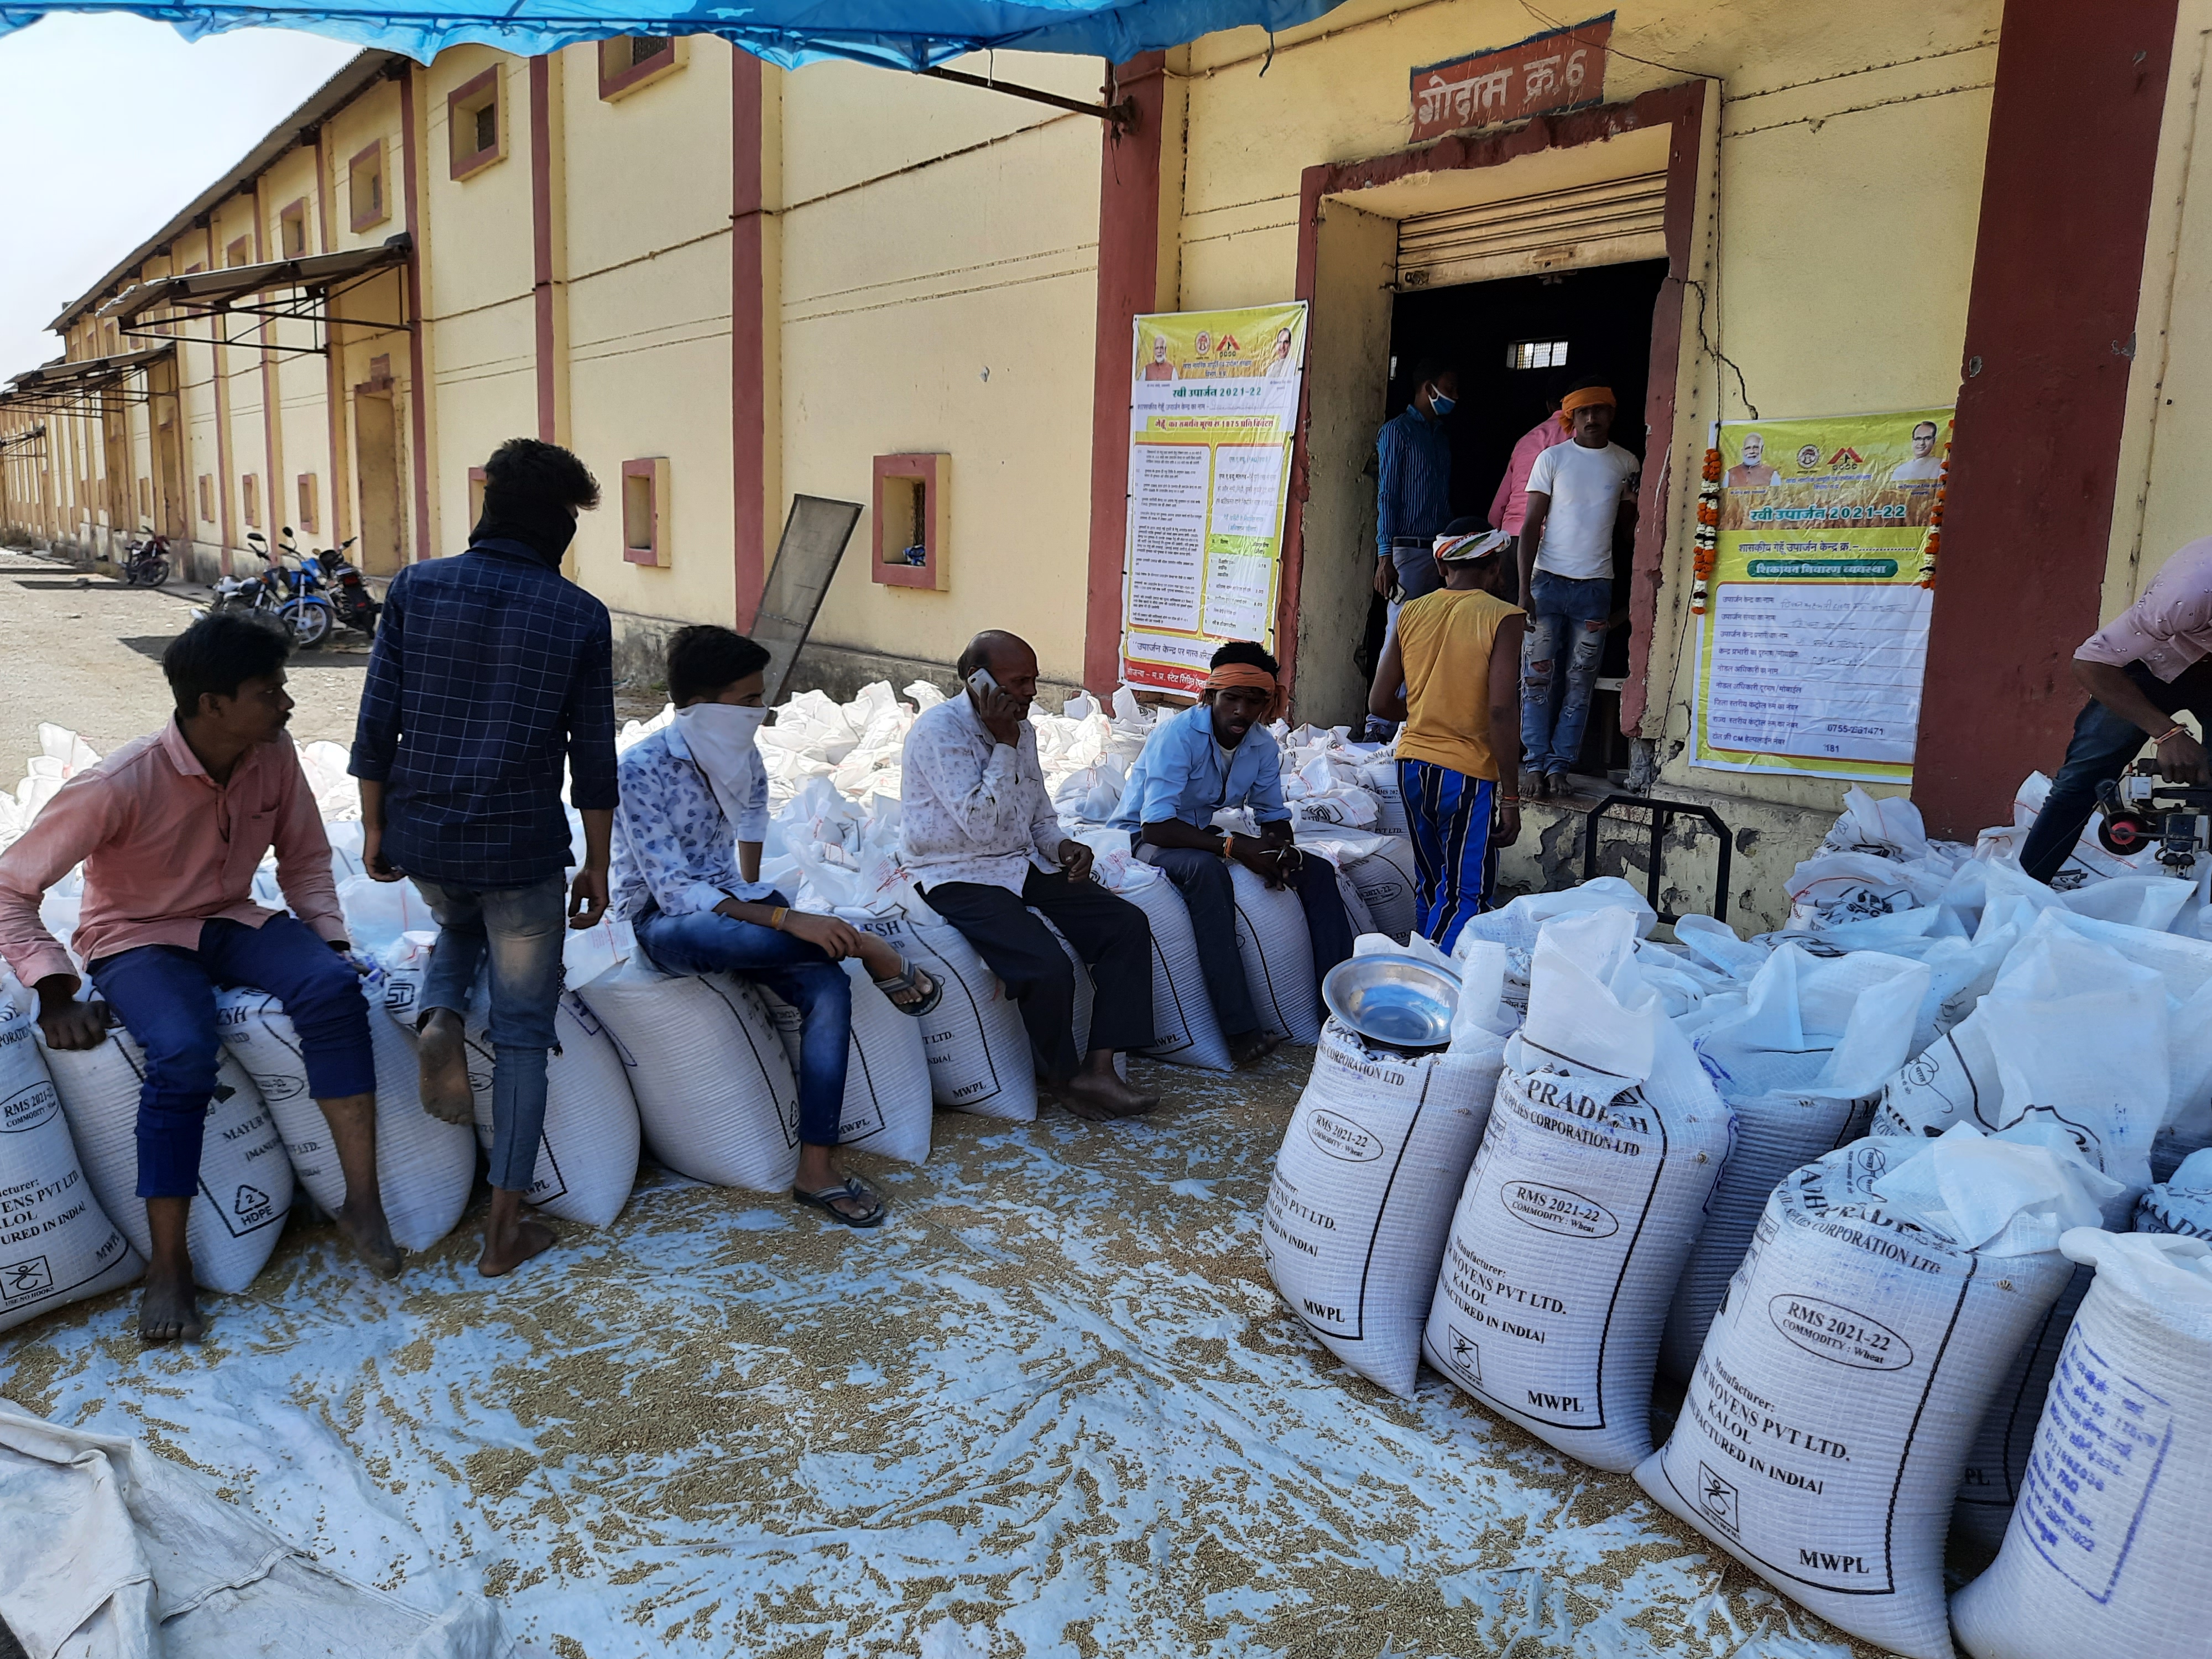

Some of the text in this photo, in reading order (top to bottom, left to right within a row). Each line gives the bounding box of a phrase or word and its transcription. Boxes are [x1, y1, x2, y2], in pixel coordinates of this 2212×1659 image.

[1418, 68, 1514, 126] गोदाम
[1566, 49, 1587, 87] 6
[1188, 385, 1217, 398] उपार्जन
[1219, 387, 1261, 397] 2021-22
[1775, 505, 1825, 521] उपार्जन
[1829, 505, 1906, 520] 2021-22
[1739, 540, 1771, 553] शासकीय
[1787, 540, 1817, 552] उपार्जन
[1819, 539, 1839, 552] केन्द्र
[1756, 562, 1887, 574] शिकायत निवारण व्यवस्था
[1723, 595, 1743, 603] उपार्जन
[1721, 612, 1741, 620] उपार्जन
[1720, 629, 1741, 638] उपार्जन
[1162, 643, 1177, 655] केन्द्र
[1178, 648, 1186, 656] पर
[1731, 647, 1749, 656] प्रभारी
[1167, 672, 1180, 684] स्टेट
[1717, 664, 1733, 672] नोडल
[1734, 665, 1759, 674] अधिकारी
[1715, 681, 1758, 691] नोडल अधिकारी
[1714, 697, 1728, 706] जिला
[1730, 698, 1747, 708] स्तरीय
[1749, 700, 1767, 711] कंट्रोल
[1786, 703, 1799, 711] नंबर
[1729, 716, 1747, 725] स्तरीय
[1748, 717, 1766, 727] कंट्रोल
[1786, 720, 1798, 729] नंबर
[1712, 732, 1723, 740] टोल
[1745, 734, 1772, 745] हेल्पलाईन
[1773, 737, 1786, 745] नंबर
[1825, 744, 1839, 753] 181
[1327, 1045, 1405, 1087] CORPORATION LTD
[952, 1081, 987, 1099] MWPL
[4, 1098, 30, 1118] RMS
[6, 1105, 45, 1128] COMMODITY
[222, 1115, 265, 1141] MAYUR
[1316, 1114, 1369, 1148] RMS 2021-22
[1503, 1089, 1640, 1157] SUPPLIES CORPORATION LTD
[1312, 1128, 1364, 1158] COMMODITY Wheat
[36, 1180, 62, 1203] PVT
[246, 1194, 255, 1204] 2
[1516, 1186, 1600, 1223] RMS 2021-22
[241, 1206, 273, 1225] HDPE
[1289, 1199, 1337, 1232] PVT LTD.
[1512, 1200, 1595, 1233] COMMODITY Wheat
[43, 1218, 57, 1233] IN
[1279, 1228, 1288, 1241] IN
[1812, 1221, 1911, 1265] CORPORATION
[1455, 1235, 1507, 1279] Manufacturer:
[1452, 1248, 1567, 1315] WOVENS PVT LTD.
[1452, 1271, 1489, 1306] KALOL
[31, 1286, 54, 1298] HOOKS
[1303, 1297, 1345, 1323] MWPL
[1485, 1314, 1499, 1329] IN
[1787, 1301, 1891, 1352] RMS 2021-22
[1782, 1318, 1885, 1365] COMMODITY Wheat
[1715, 1356, 1776, 1413] Manufacturer:
[1527, 1389, 1584, 1412] MWPL
[1707, 1398, 1752, 1445] KALOL
[1708, 1373, 1851, 1462] WOVENS PVT LTD.
[1749, 1455, 1765, 1474] IN
[1798, 1548, 1870, 1574] MWPL
